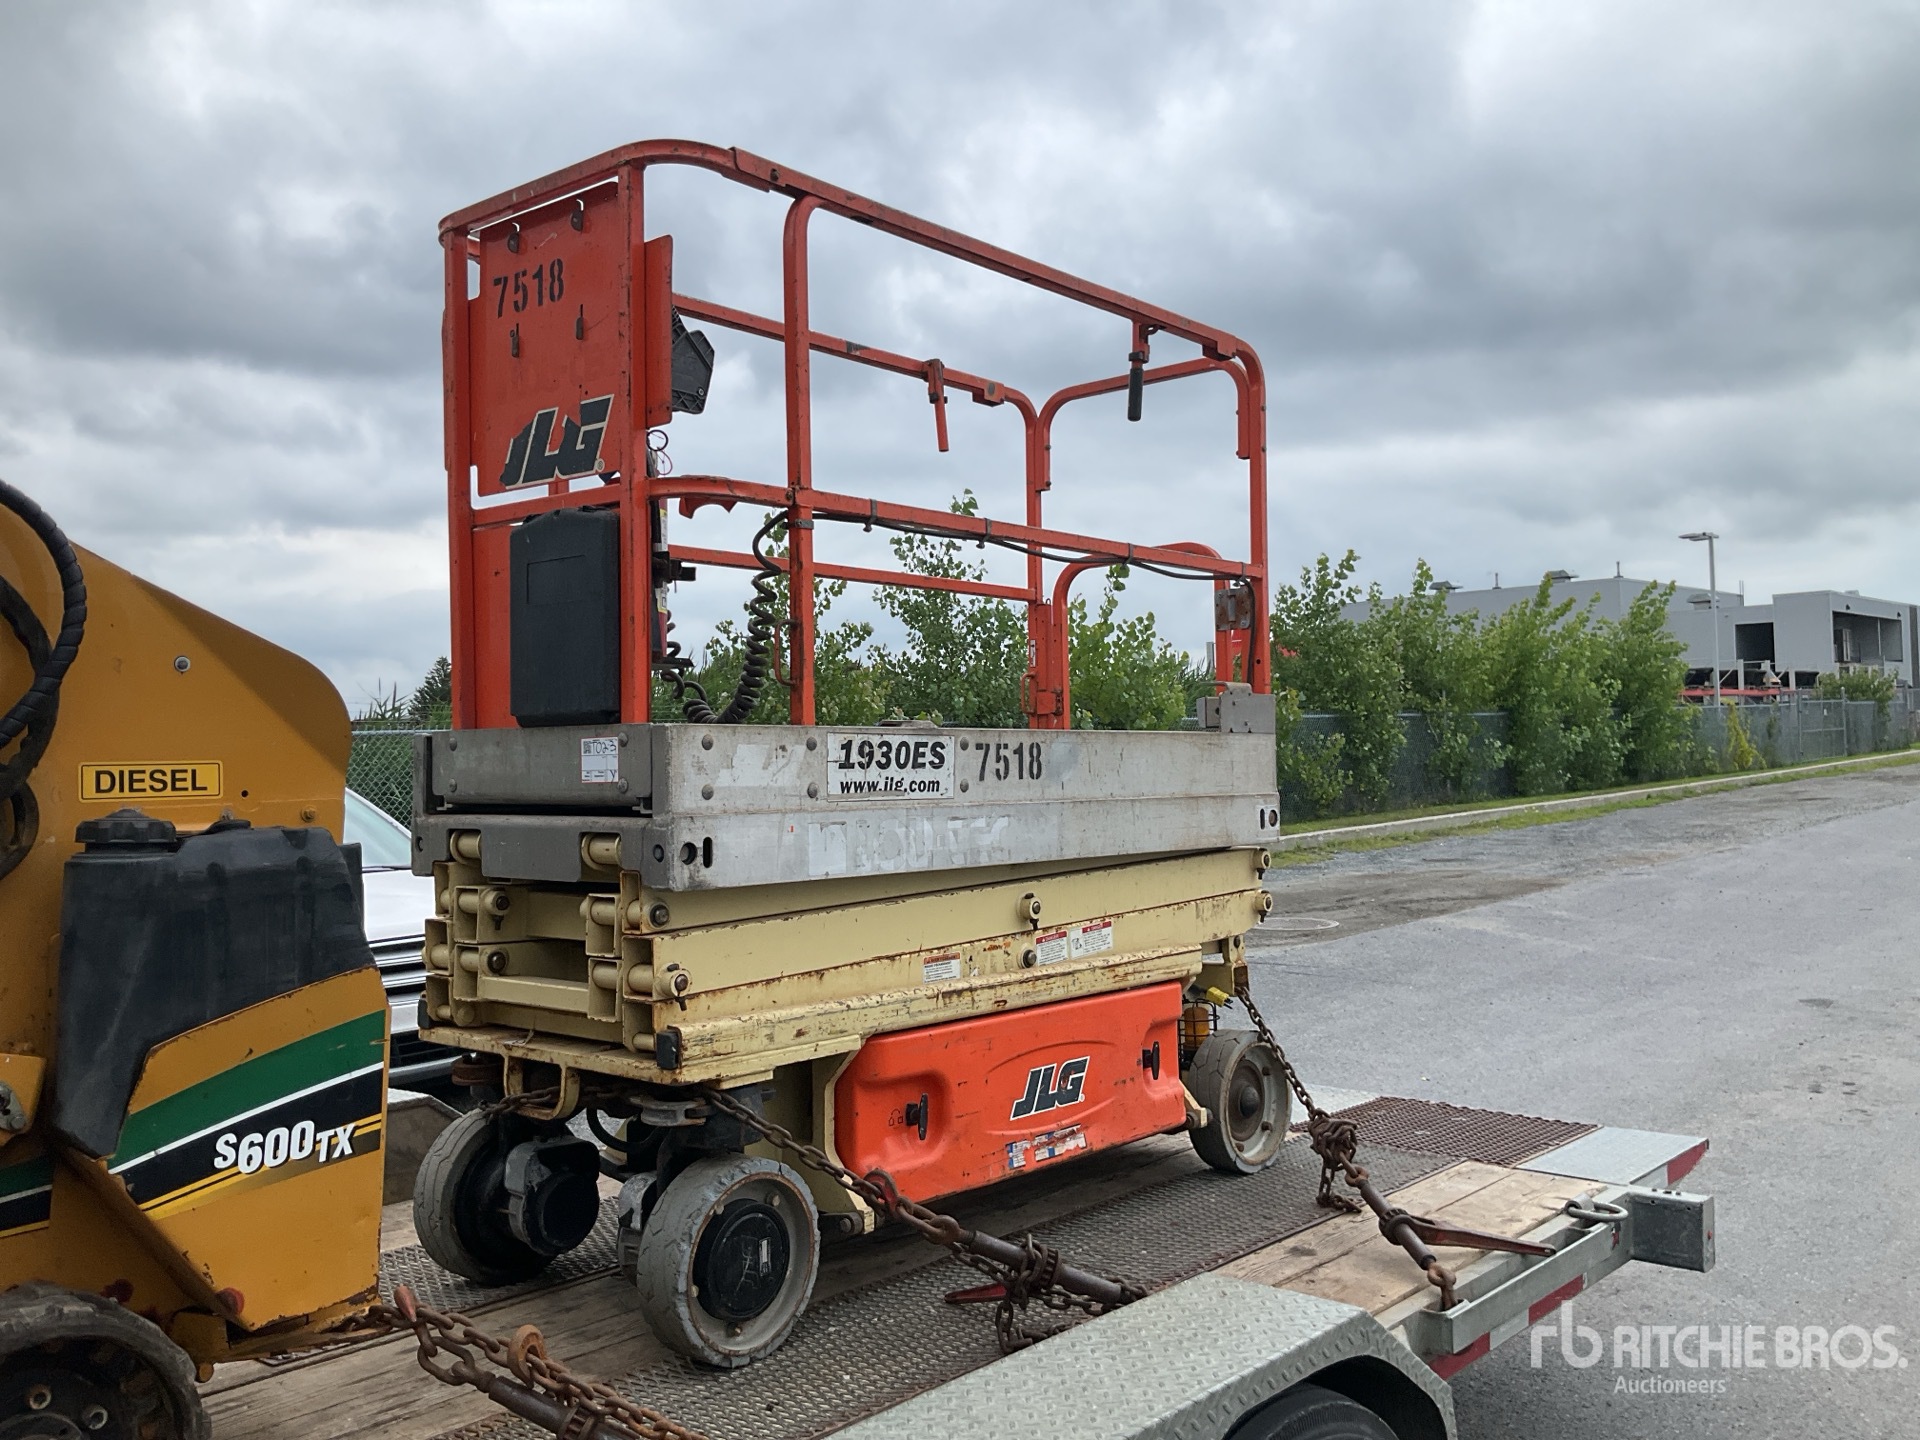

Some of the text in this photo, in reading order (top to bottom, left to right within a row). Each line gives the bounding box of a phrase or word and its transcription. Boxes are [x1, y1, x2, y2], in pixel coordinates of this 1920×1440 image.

[493, 258, 565, 319] 7518
[499, 394, 615, 490] JLG
[838, 740, 947, 770] 1930ES
[975, 742, 1043, 782] 7518
[95, 769, 208, 794] DIESEL
[1010, 1055, 1091, 1121] JLG
